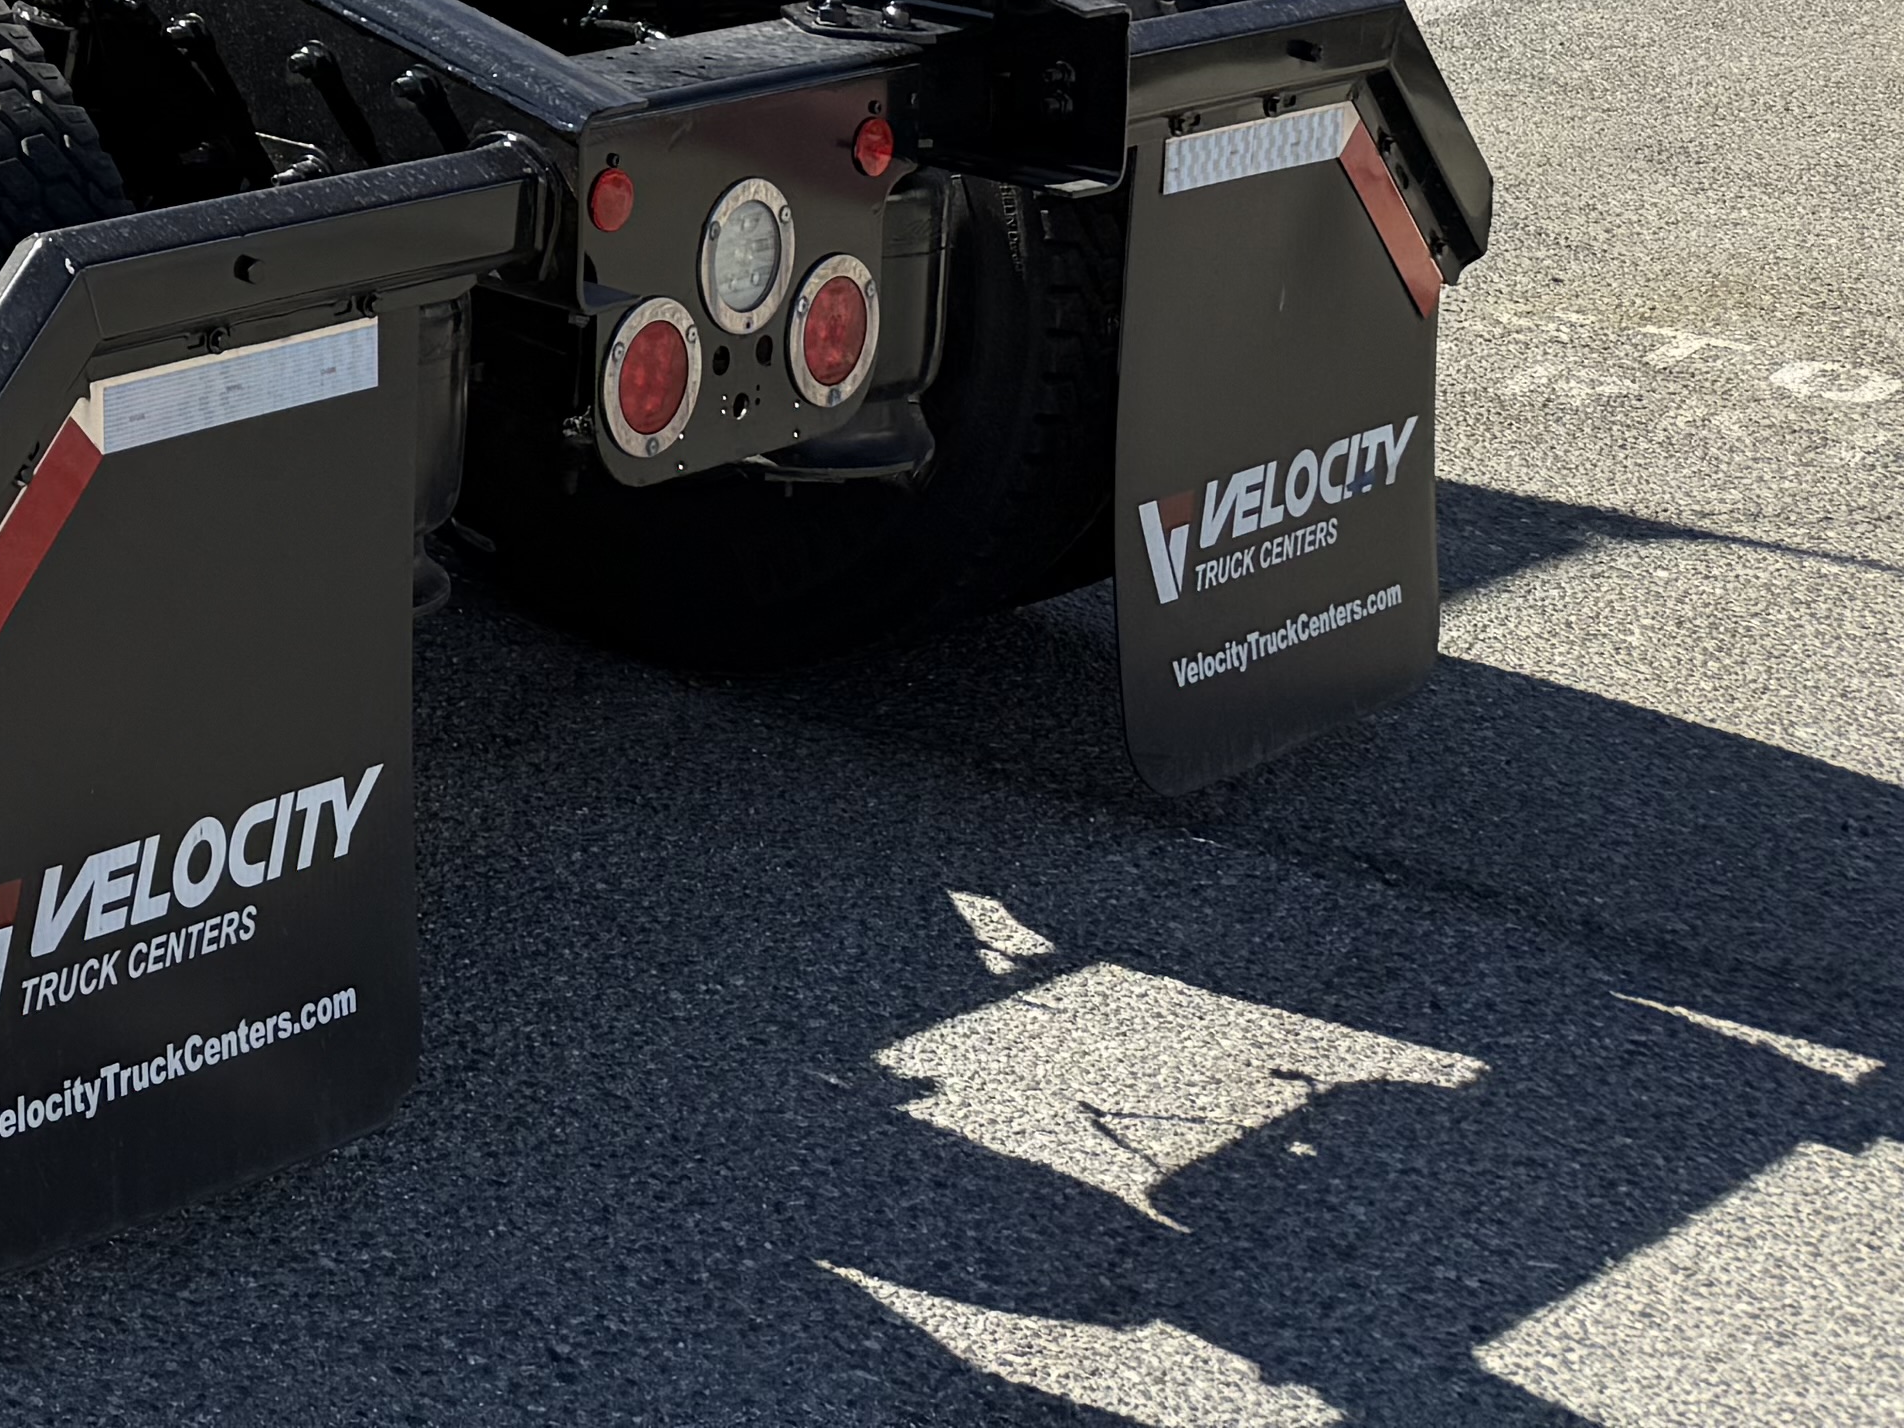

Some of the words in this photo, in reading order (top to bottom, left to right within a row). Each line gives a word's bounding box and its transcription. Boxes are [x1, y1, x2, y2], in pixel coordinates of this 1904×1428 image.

[1199, 415, 1418, 549] VELOCITY
[1195, 546, 1255, 592] TRUCK
[1260, 517, 1338, 569] CENTERS
[1172, 584, 1402, 687] VelocityTruckCenters.com
[30, 763, 384, 958] VELOCITY
[20, 949, 121, 1016] TRUCK
[128, 905, 257, 979] CENTERS
